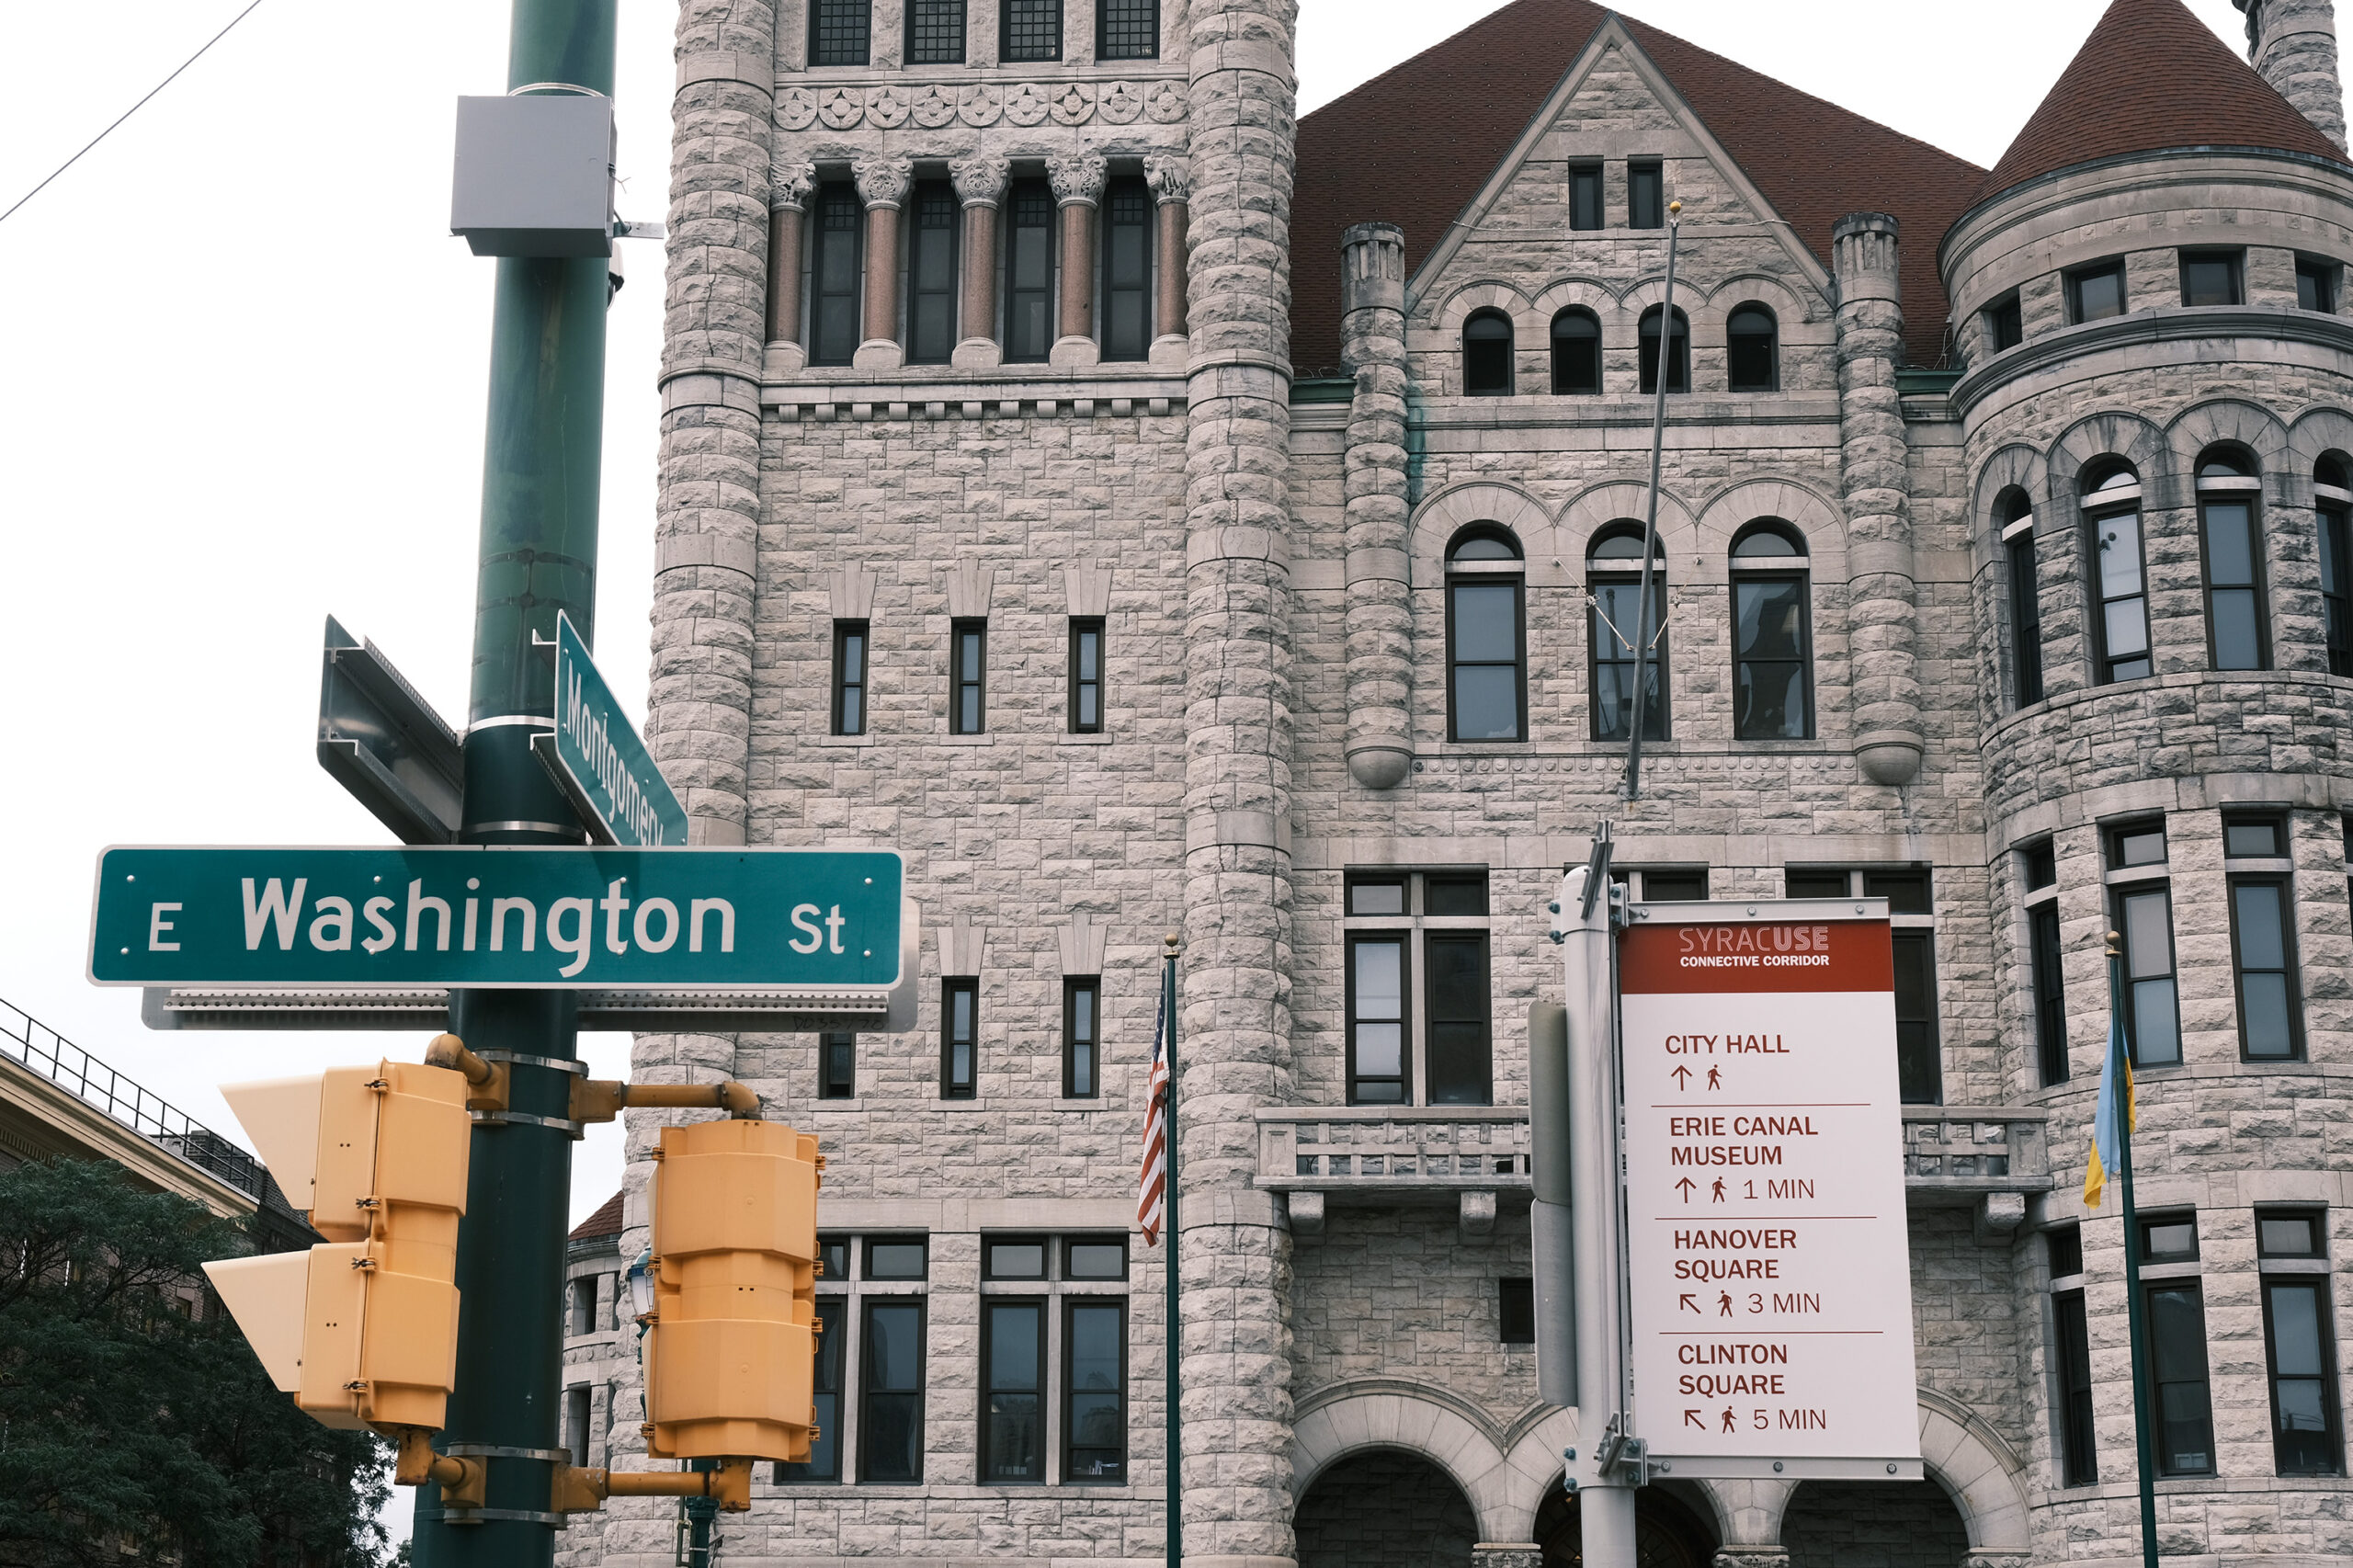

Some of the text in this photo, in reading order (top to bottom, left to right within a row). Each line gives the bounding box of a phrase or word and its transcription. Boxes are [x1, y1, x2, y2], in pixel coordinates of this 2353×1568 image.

[149, 877, 846, 978] E Washington St
[1678, 926, 1829, 952] SYRACUSE
[1680, 955, 1830, 968] CONNECTIVE CORRIDOR
[1665, 1035, 1790, 1054] CITY HALL
[1670, 1116, 1819, 1137] ERIE CANAL
[1671, 1146, 1782, 1165] MUSEUM
[1744, 1179, 1814, 1199] 1 MIN
[1674, 1230, 1797, 1250] HANOVER
[1675, 1259, 1779, 1283] SQUARE
[1748, 1293, 1820, 1314] 3 MIN
[1677, 1345, 1788, 1365] CLINTON
[1678, 1374, 1786, 1399] SQUARE
[1754, 1409, 1826, 1430] 5 MIN
